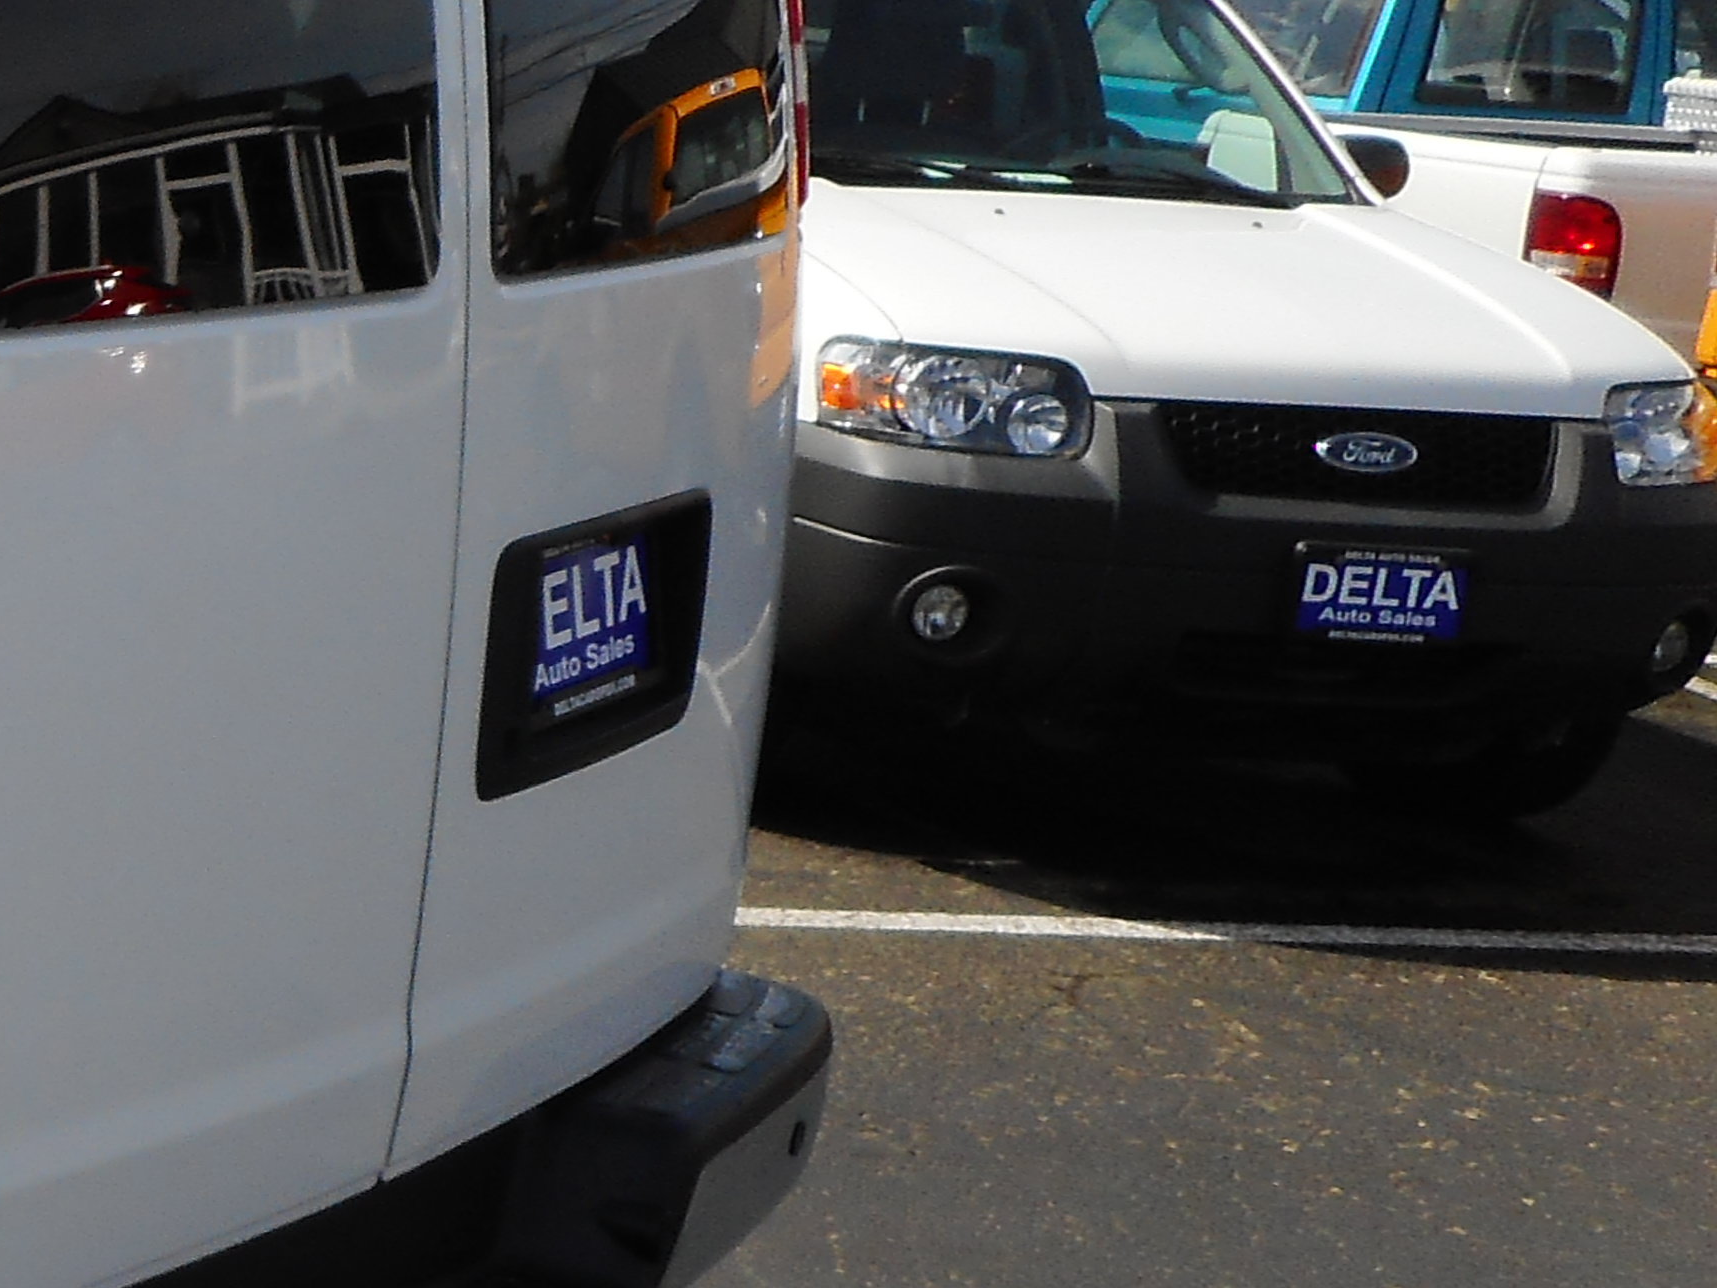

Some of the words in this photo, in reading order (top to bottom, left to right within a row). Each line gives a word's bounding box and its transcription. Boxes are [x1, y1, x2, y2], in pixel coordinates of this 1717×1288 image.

[1342, 438, 1397, 464] Ford
[1302, 564, 1459, 611] DELTA
[1318, 607, 1371, 623] Auto
[1377, 610, 1436, 627] Sales
[534, 657, 581, 692] Auto
[586, 633, 635, 670] Sales
